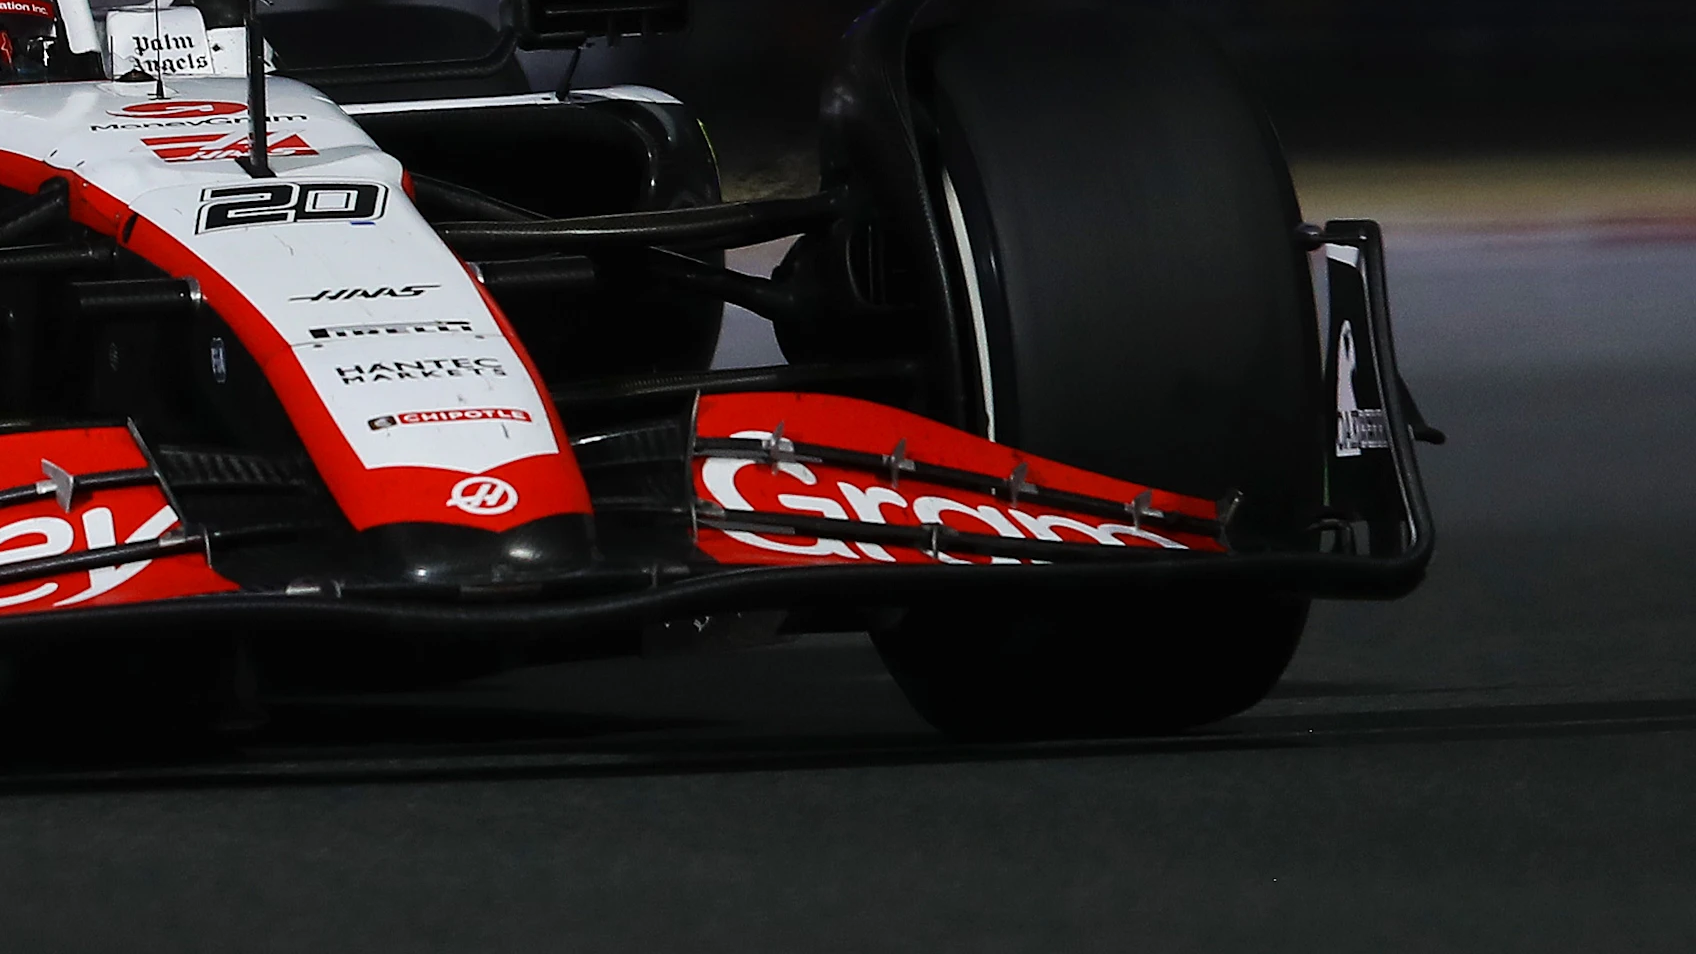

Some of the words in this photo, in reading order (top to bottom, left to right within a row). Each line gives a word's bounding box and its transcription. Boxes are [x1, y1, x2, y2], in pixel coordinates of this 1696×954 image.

[132, 33, 195, 57] Palm
[128, 52, 208, 74] Angels
[90, 113, 308, 133] MoneyGrm
[194, 181, 390, 235] 20
[290, 284, 441, 301] HAAS
[310, 320, 472, 339] PIRELLI
[335, 358, 503, 377] HANTEC
[342, 368, 507, 385] MARKETS
[404, 409, 526, 422] CHIPOTLE
